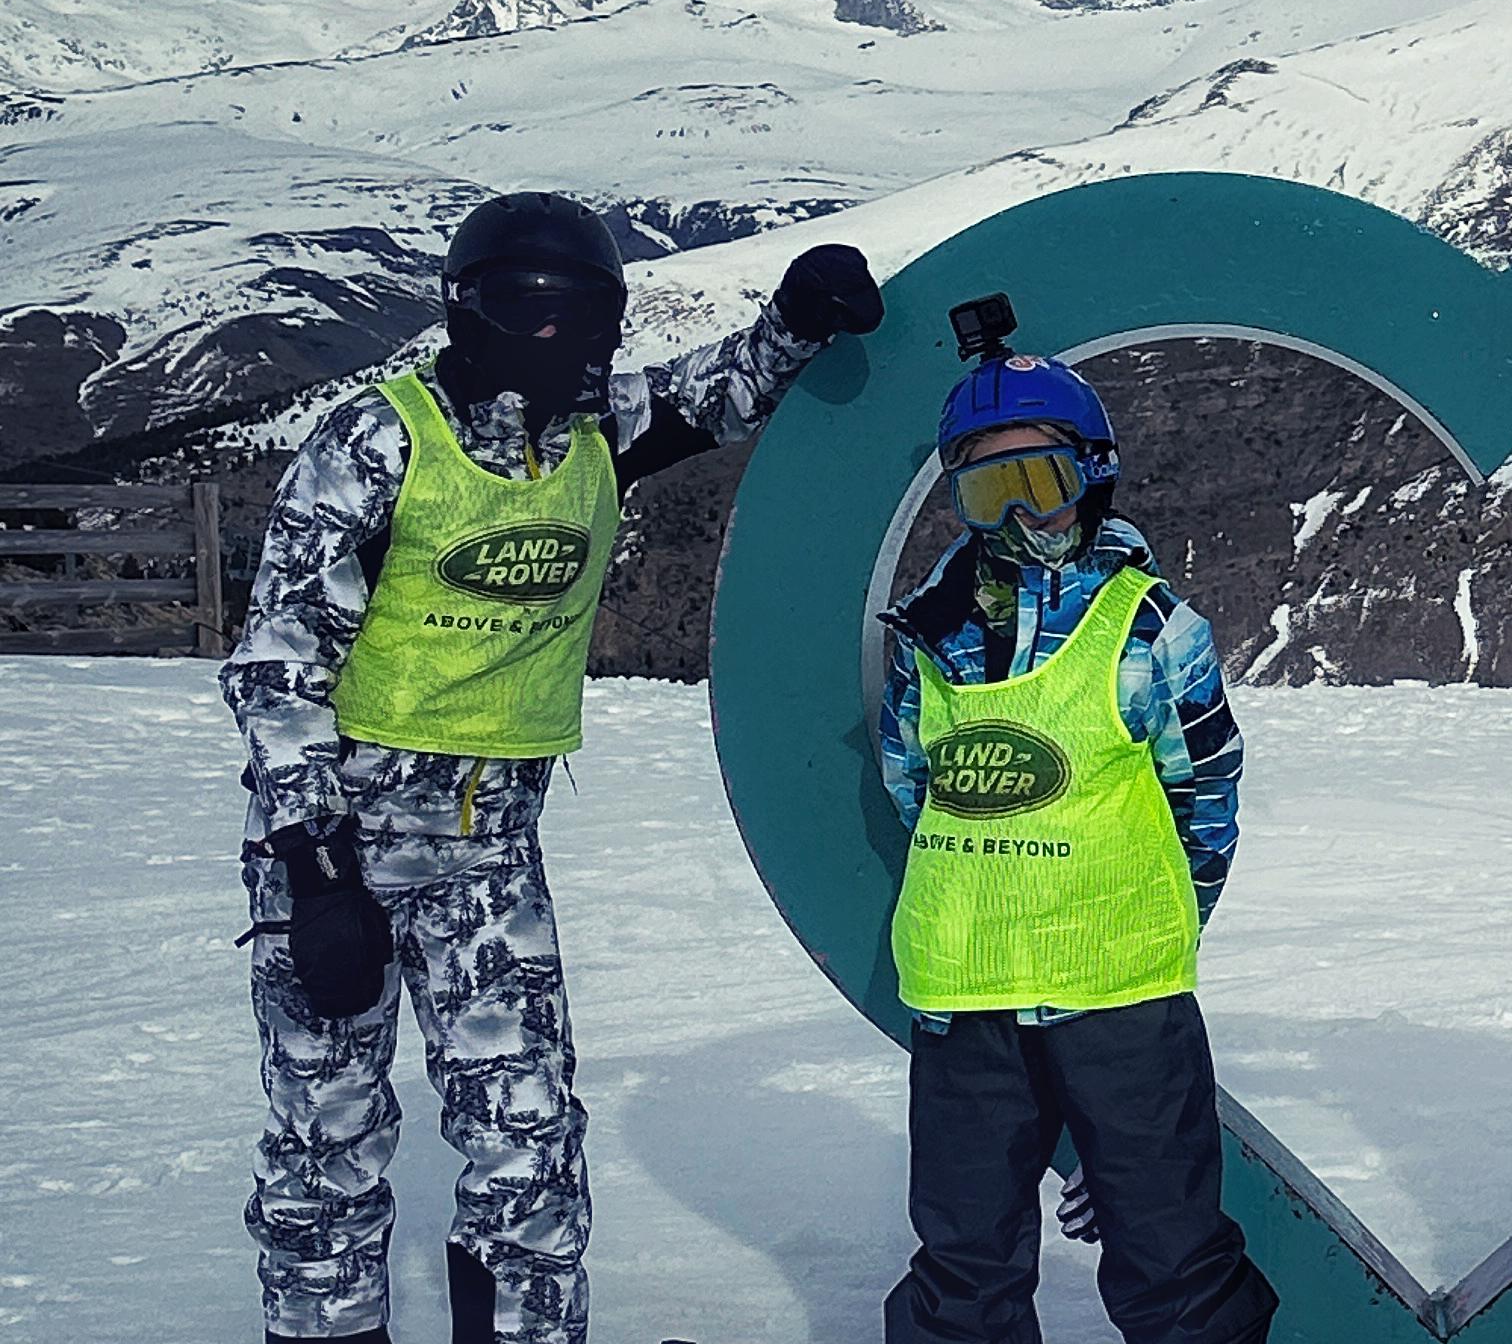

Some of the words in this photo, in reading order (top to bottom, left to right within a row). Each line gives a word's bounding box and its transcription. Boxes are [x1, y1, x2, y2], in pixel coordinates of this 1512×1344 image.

[423, 613, 503, 632] ABOVE
[509, 620, 523, 634] &
[934, 769, 1036, 795] ROVER
[962, 837, 974, 853] &
[983, 838, 1071, 857] BEYOND
